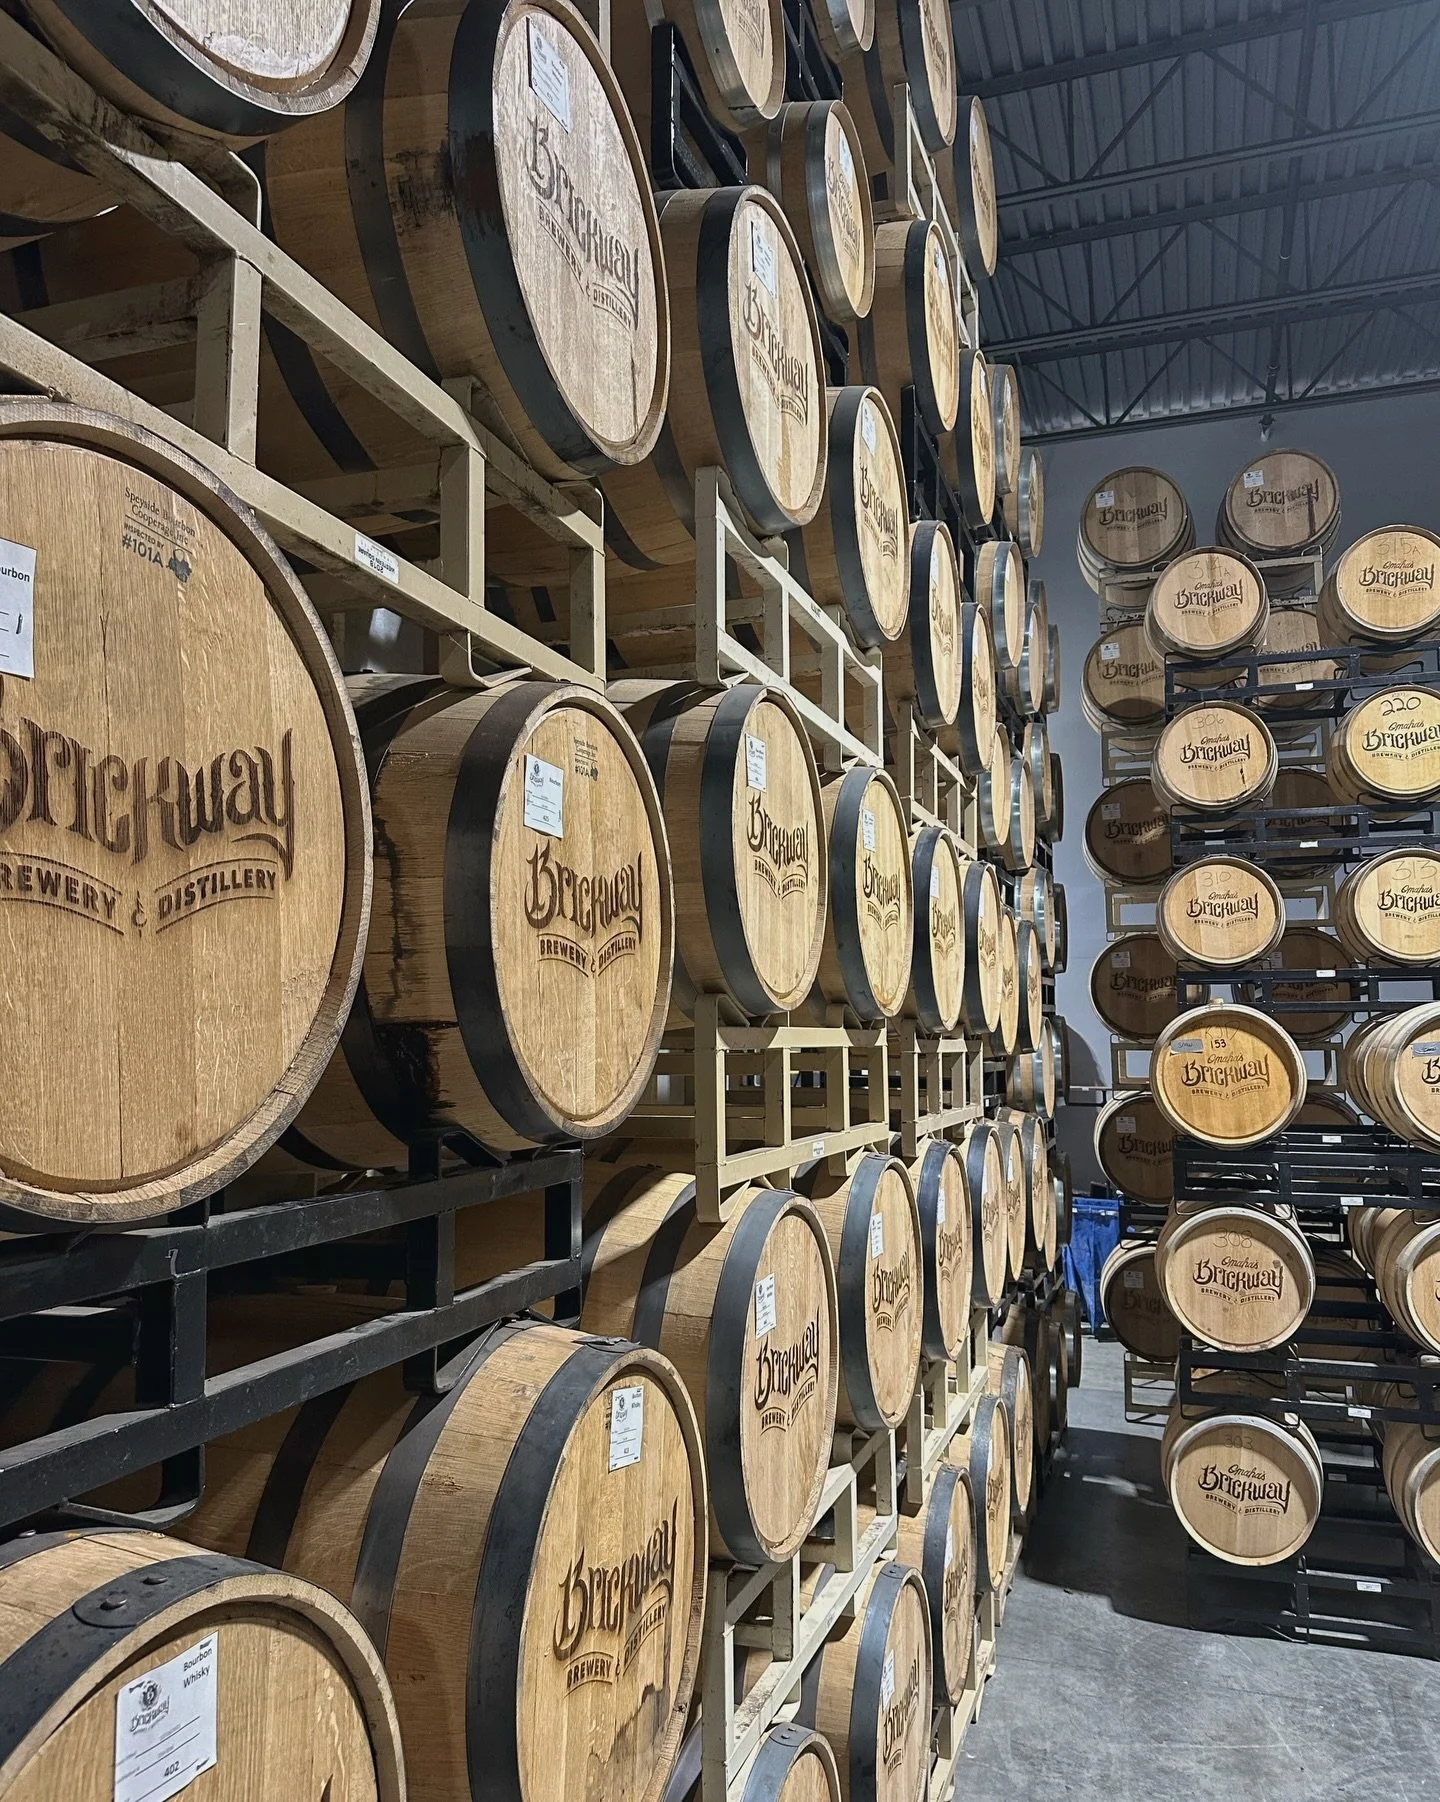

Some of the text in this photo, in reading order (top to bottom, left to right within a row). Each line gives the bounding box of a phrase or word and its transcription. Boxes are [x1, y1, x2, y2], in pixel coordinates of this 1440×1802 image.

[524, 115, 639, 331] Brickway
[539, 205, 583, 281] BREWERY
[593, 287, 632, 328] DISTILLERY
[743, 282, 809, 426] Brickway
[125, 487, 196, 538] Speyside Bourbon
[1099, 496, 1168, 526] Brickway
[122, 534, 164, 569] #101A
[0, 566, 30, 582] urbon
[1359, 563, 1435, 591] Brickway
[1174, 579, 1243, 609] Brickway
[1381, 697, 1422, 716] 220
[1180, 733, 1251, 763] Brickway
[747, 791, 809, 887] Brickway
[1391, 860, 1438, 881] 313
[0, 863, 116, 920] REWERY
[158, 868, 277, 920] DISTILLERY
[524, 840, 643, 944] Brickway
[1186, 892, 1259, 919] Brickway
[540, 938, 587, 971] BREWERY
[599, 938, 637, 966] DISTILLERY
[1210, 1038, 1227, 1049] 153
[1181, 1053, 1270, 1088] Brickway
[1191, 1088, 1222, 1097] BREWERY
[1231, 1085, 1265, 1097] DISTILLERY
[1213, 1227, 1253, 1248] 308
[1192, 1257, 1284, 1300] Brickway
[1201, 1287, 1231, 1301] BREWERY
[1240, 1295, 1276, 1303] DISTILLERY
[754, 1306, 820, 1411] Brickway
[761, 1412, 785, 1430] BREWERY
[1228, 1464, 1266, 1481] Omaha's
[1198, 1464, 1291, 1514] Brickway
[1205, 1493, 1236, 1510] BREWERY
[1244, 1507, 1280, 1515] DISTILLERY
[553, 1496, 678, 1662] Brickway
[183, 1648, 213, 1672] Bourbon
[566, 1659, 612, 1689] BREWERY
[624, 1603, 667, 1660] DISTILLERY
[183, 1664, 211, 1689] Whisky
[164, 1761, 180, 1778] 402
